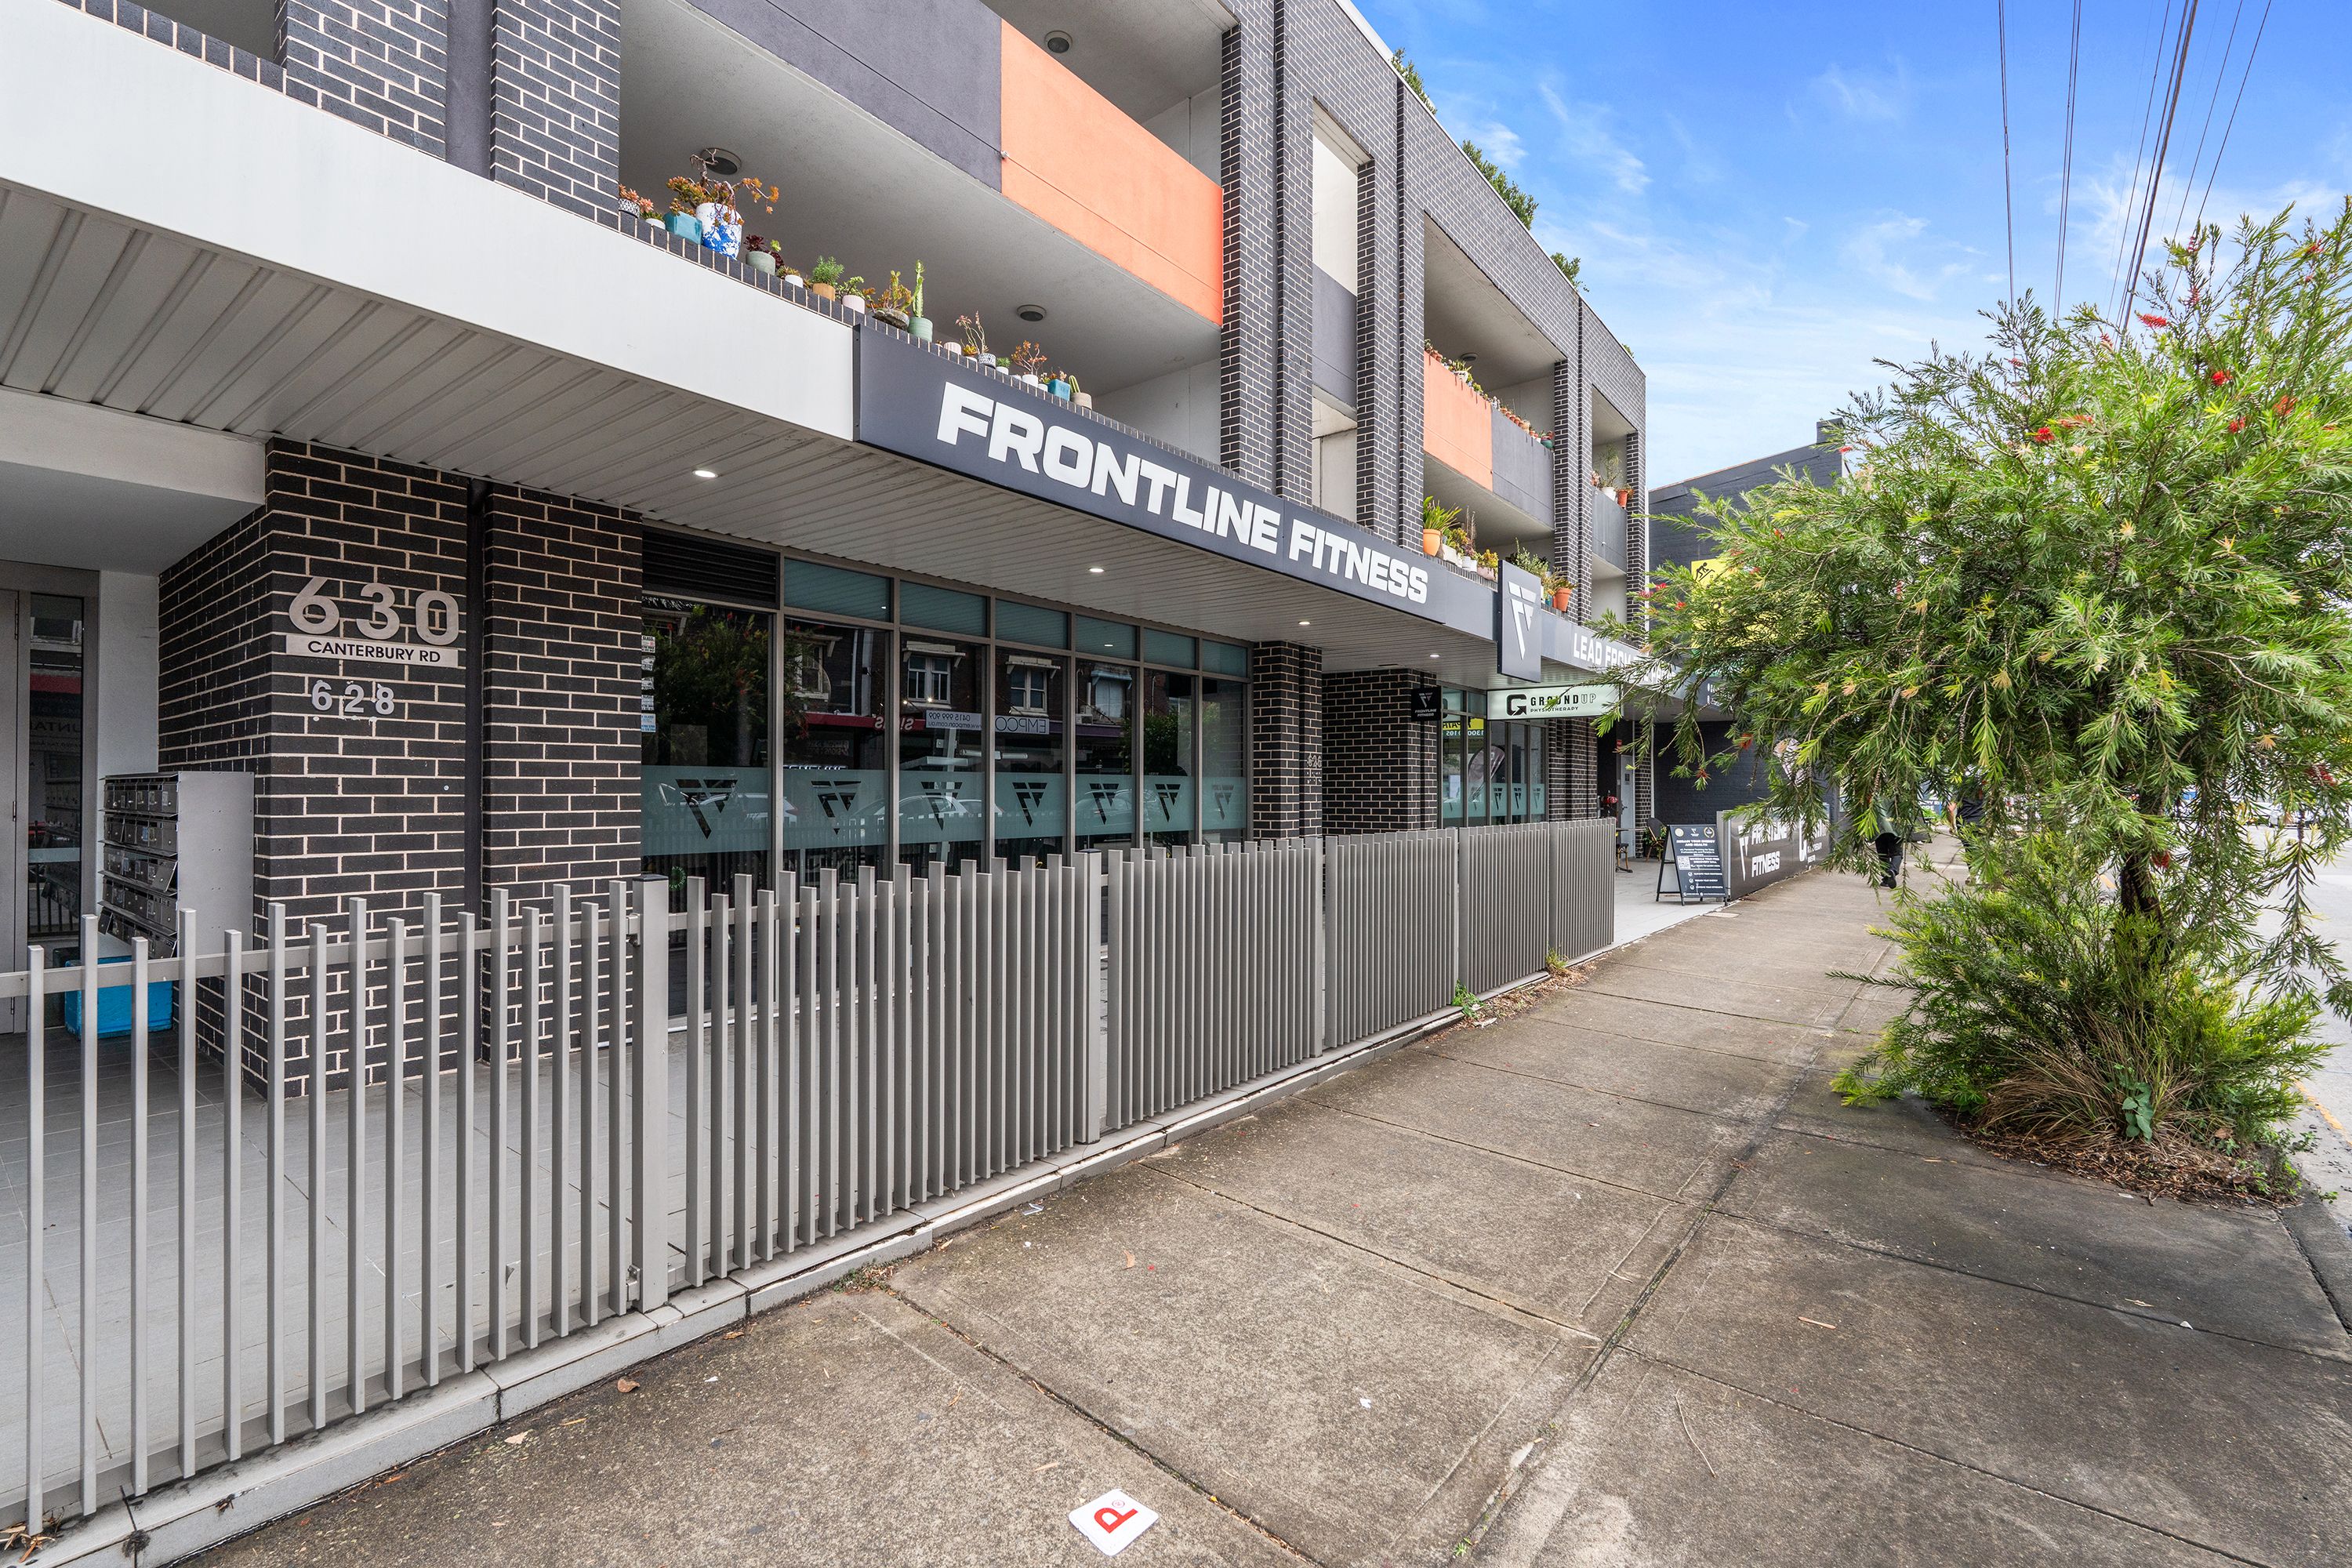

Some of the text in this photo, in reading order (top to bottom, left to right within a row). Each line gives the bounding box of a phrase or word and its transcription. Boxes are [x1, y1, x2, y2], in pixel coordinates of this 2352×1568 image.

[937, 381, 1428, 604] FRONTLINE FITNESS
[289, 576, 459, 645] 630
[307, 640, 441, 663] CANTERBURY RD
[1573, 633, 1602, 666] LEAD
[311, 680, 395, 715] 628
[1751, 851, 1780, 877] FITNESS
[1094, 1508, 1138, 1534] P
